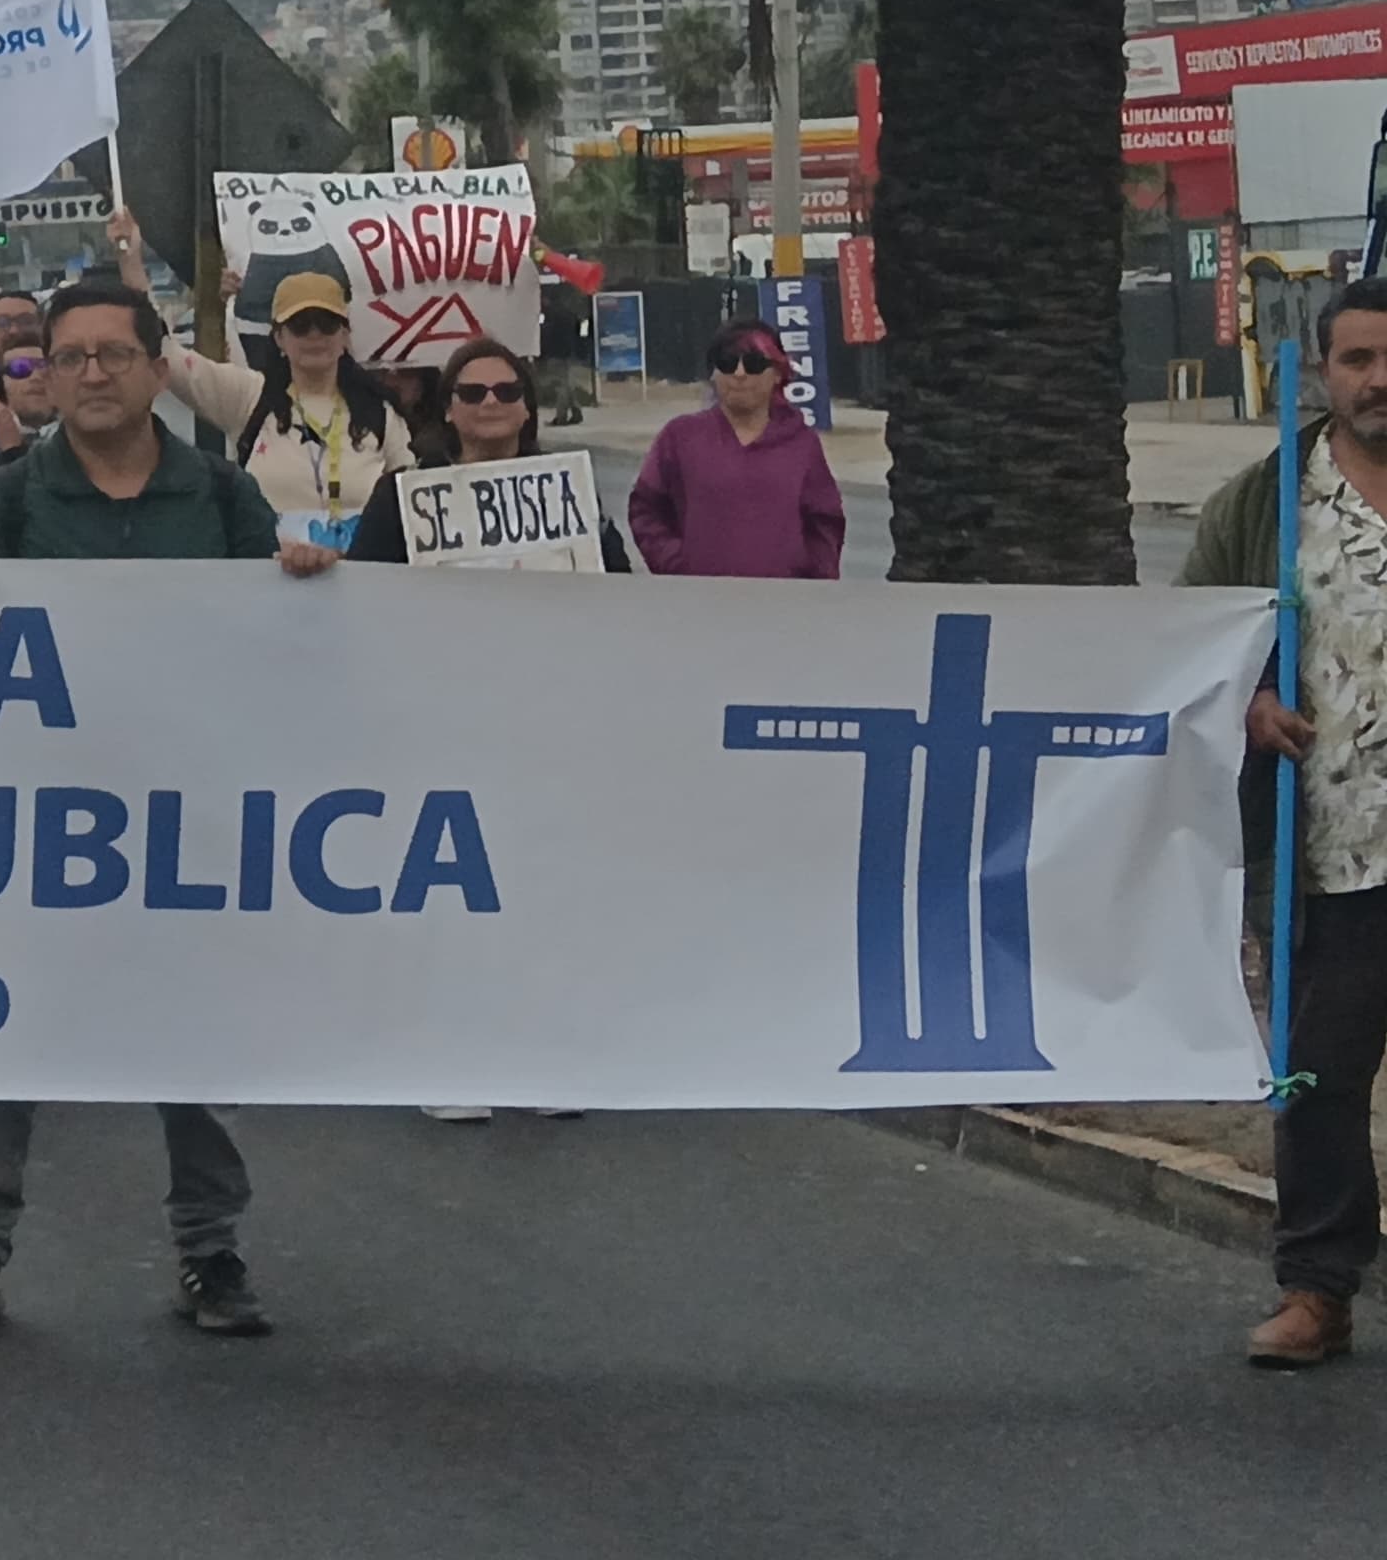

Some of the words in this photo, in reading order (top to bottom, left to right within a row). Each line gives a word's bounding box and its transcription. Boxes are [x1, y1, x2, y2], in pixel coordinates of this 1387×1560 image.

[348, 203, 532, 295] PAGUEN
[367, 292, 484, 363] YA
[410, 482, 464, 553] SE
[469, 470, 589, 547] BUSCA
